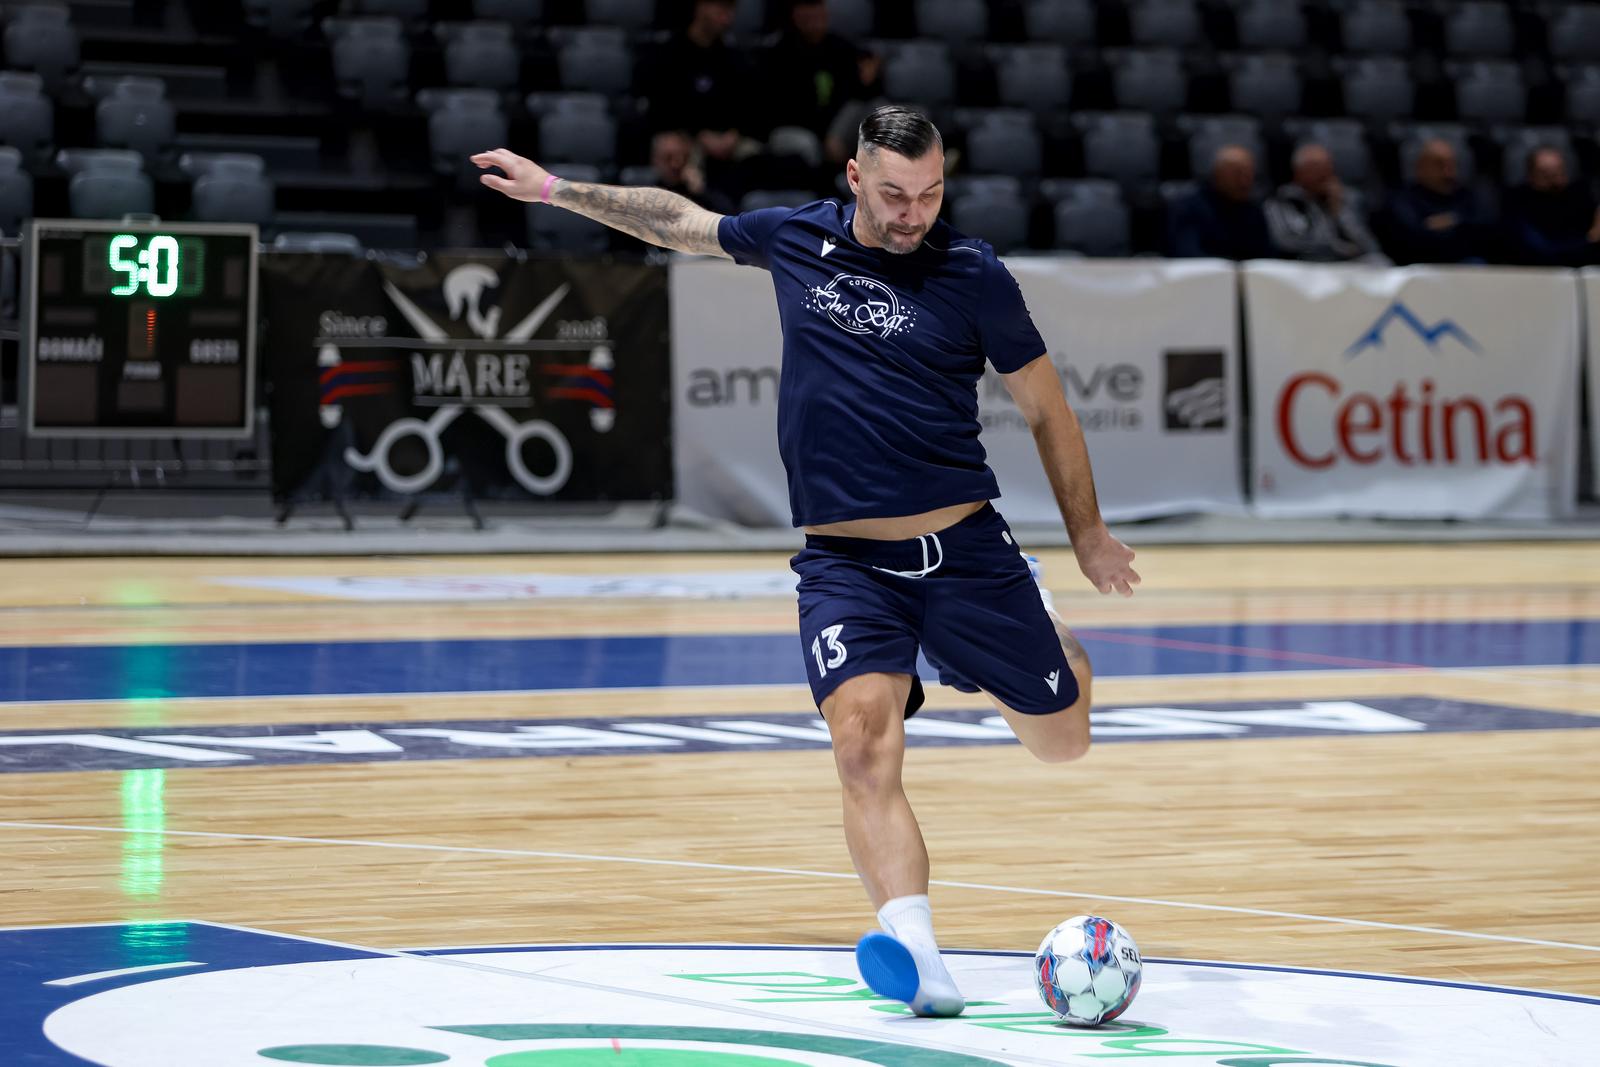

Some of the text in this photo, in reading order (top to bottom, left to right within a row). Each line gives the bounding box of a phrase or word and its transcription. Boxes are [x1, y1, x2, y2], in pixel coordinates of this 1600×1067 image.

[320, 310, 388, 336] Since
[855, 299, 908, 329] Bar
[411, 349, 530, 400] MARE
[1274, 370, 1538, 472] Cetina
[811, 624, 847, 678] 13
